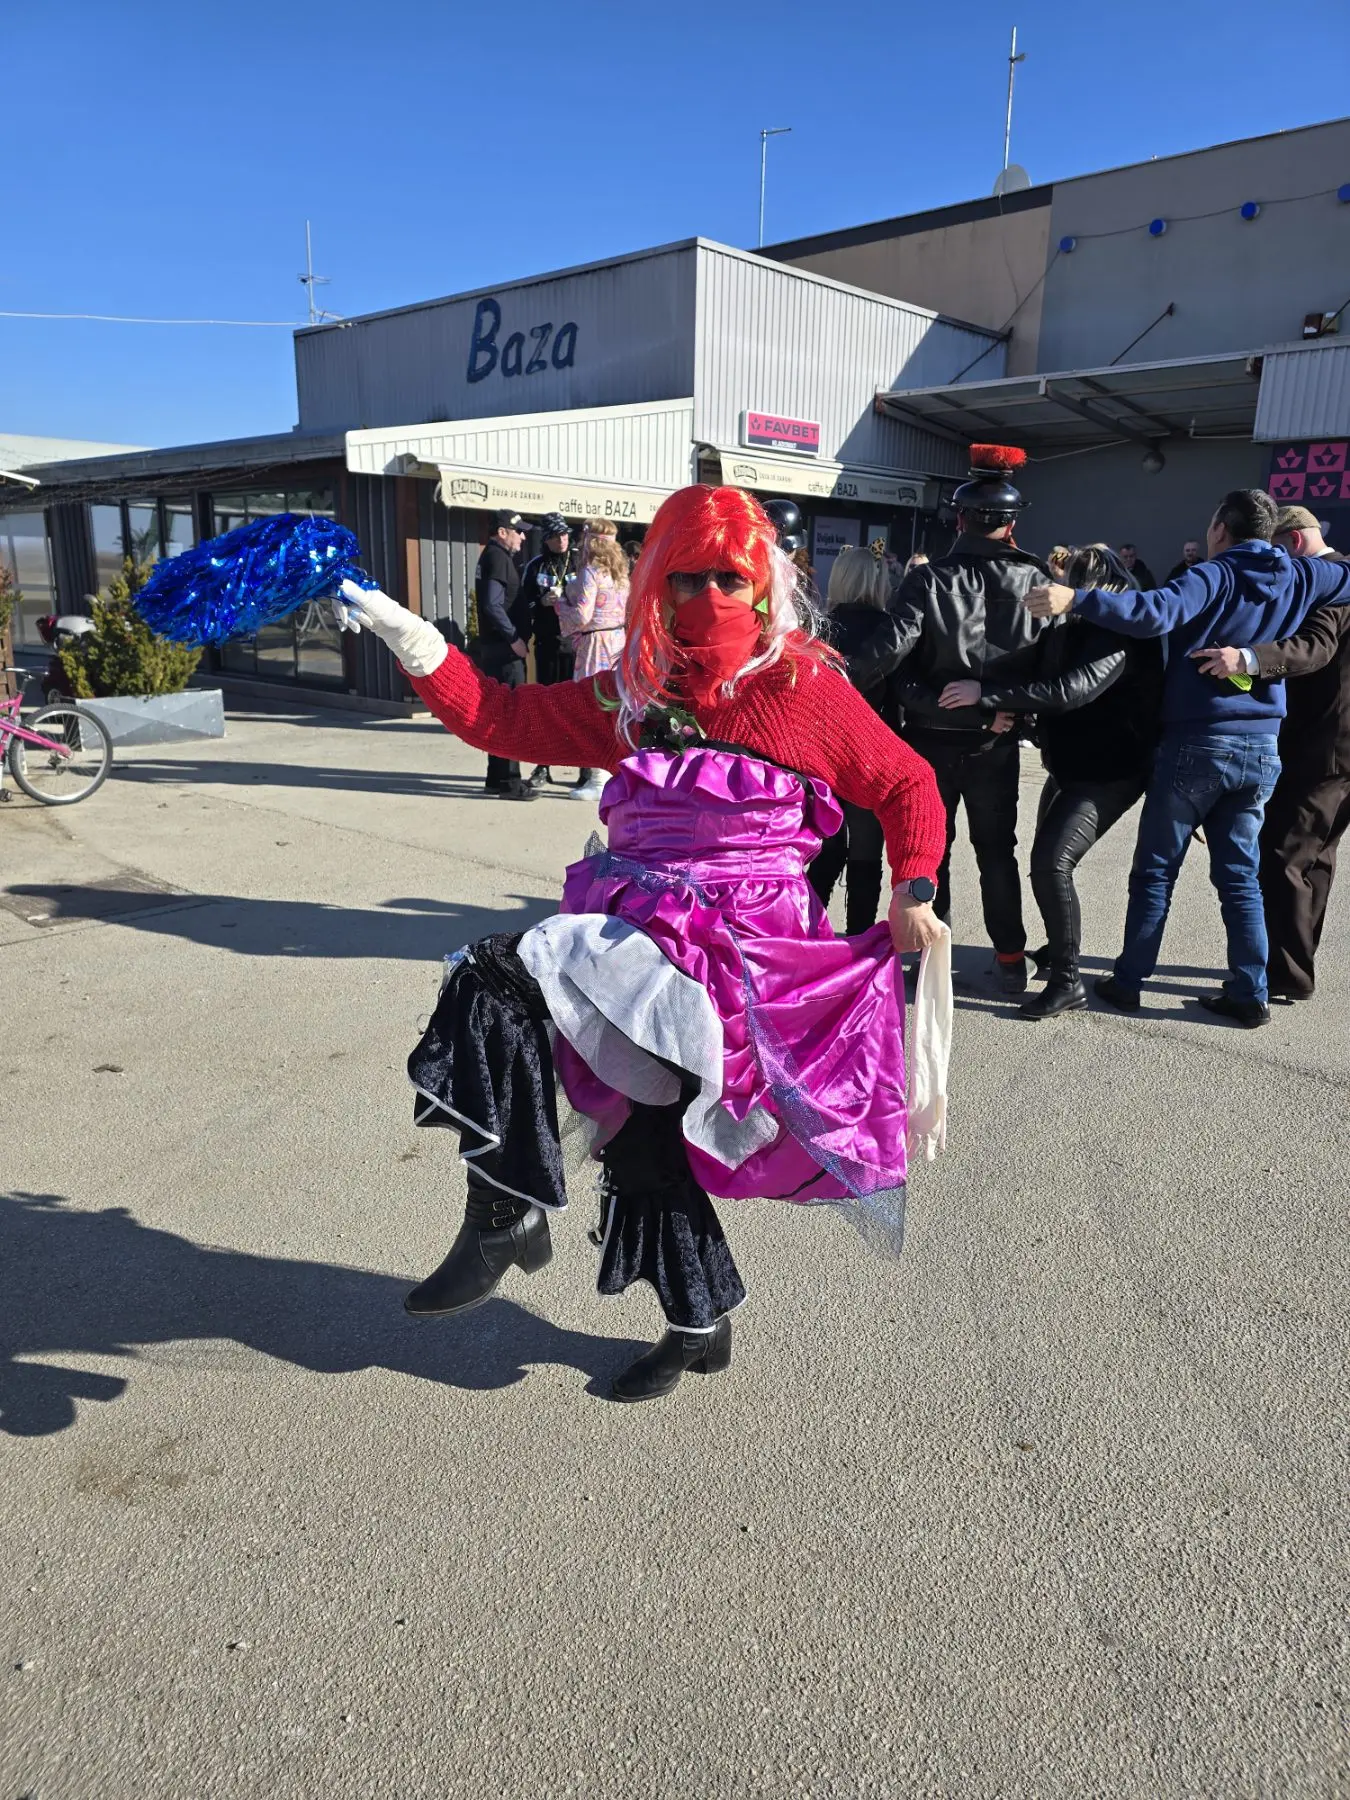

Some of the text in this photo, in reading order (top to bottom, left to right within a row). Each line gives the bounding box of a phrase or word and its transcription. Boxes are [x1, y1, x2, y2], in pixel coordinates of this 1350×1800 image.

[467, 298, 579, 383] Baza
[764, 420, 819, 439] FAVBET
[837, 482, 858, 497] BAZA
[559, 498, 583, 513] caffe
[586, 501, 601, 515] bar
[605, 500, 637, 517] BAZA
